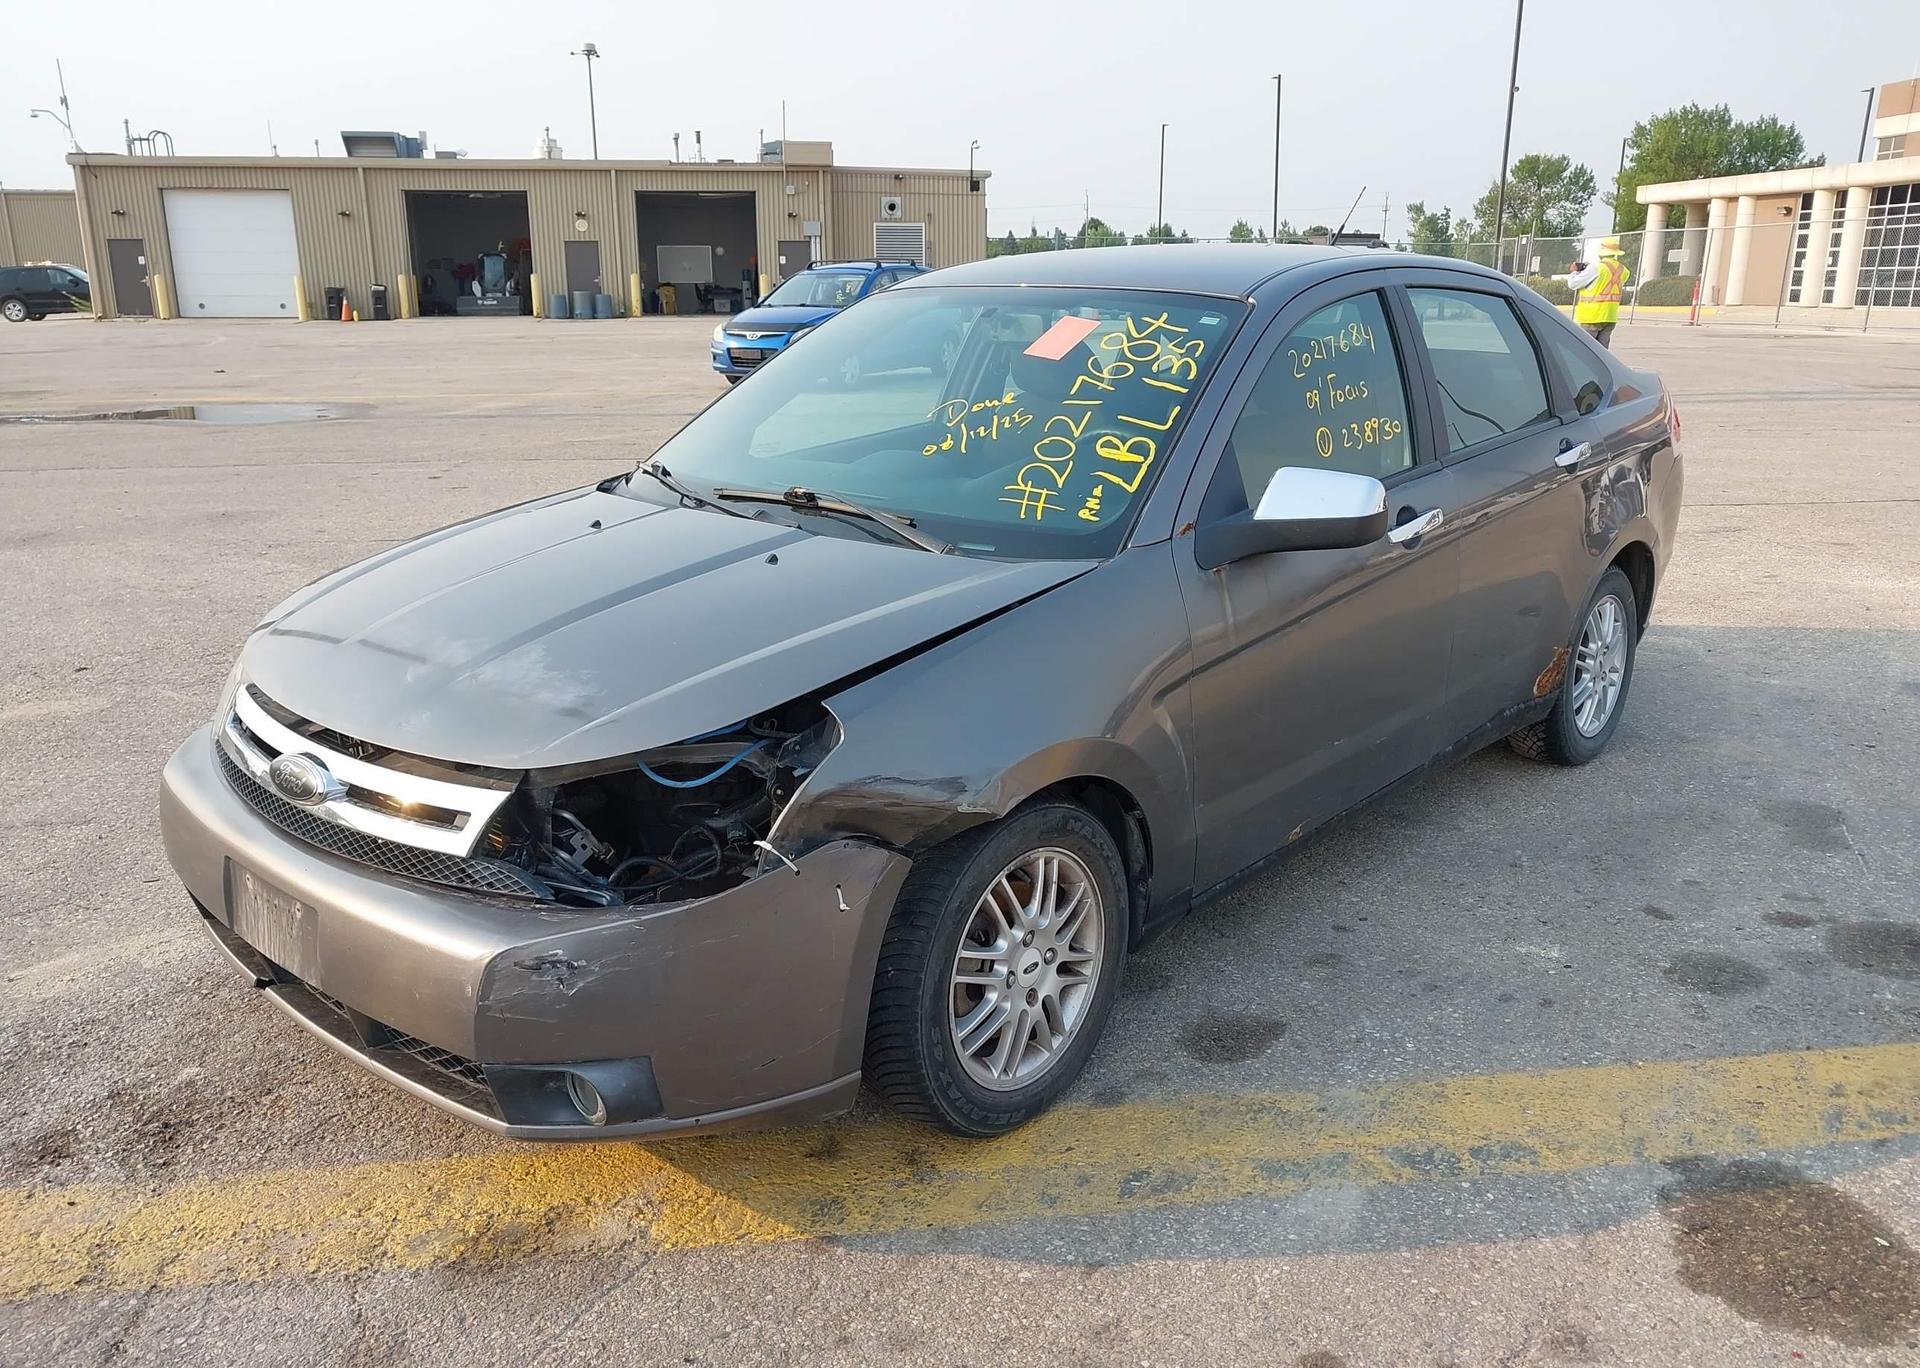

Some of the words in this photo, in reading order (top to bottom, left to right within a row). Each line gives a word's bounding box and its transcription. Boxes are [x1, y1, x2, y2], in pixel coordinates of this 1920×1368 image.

[1287, 322, 1376, 378] 20217684
[1326, 373, 1369, 409] Focus
[926, 392, 1017, 427] Done
[1341, 417, 1401, 450] 238930
[274, 761, 307, 794] Ford
